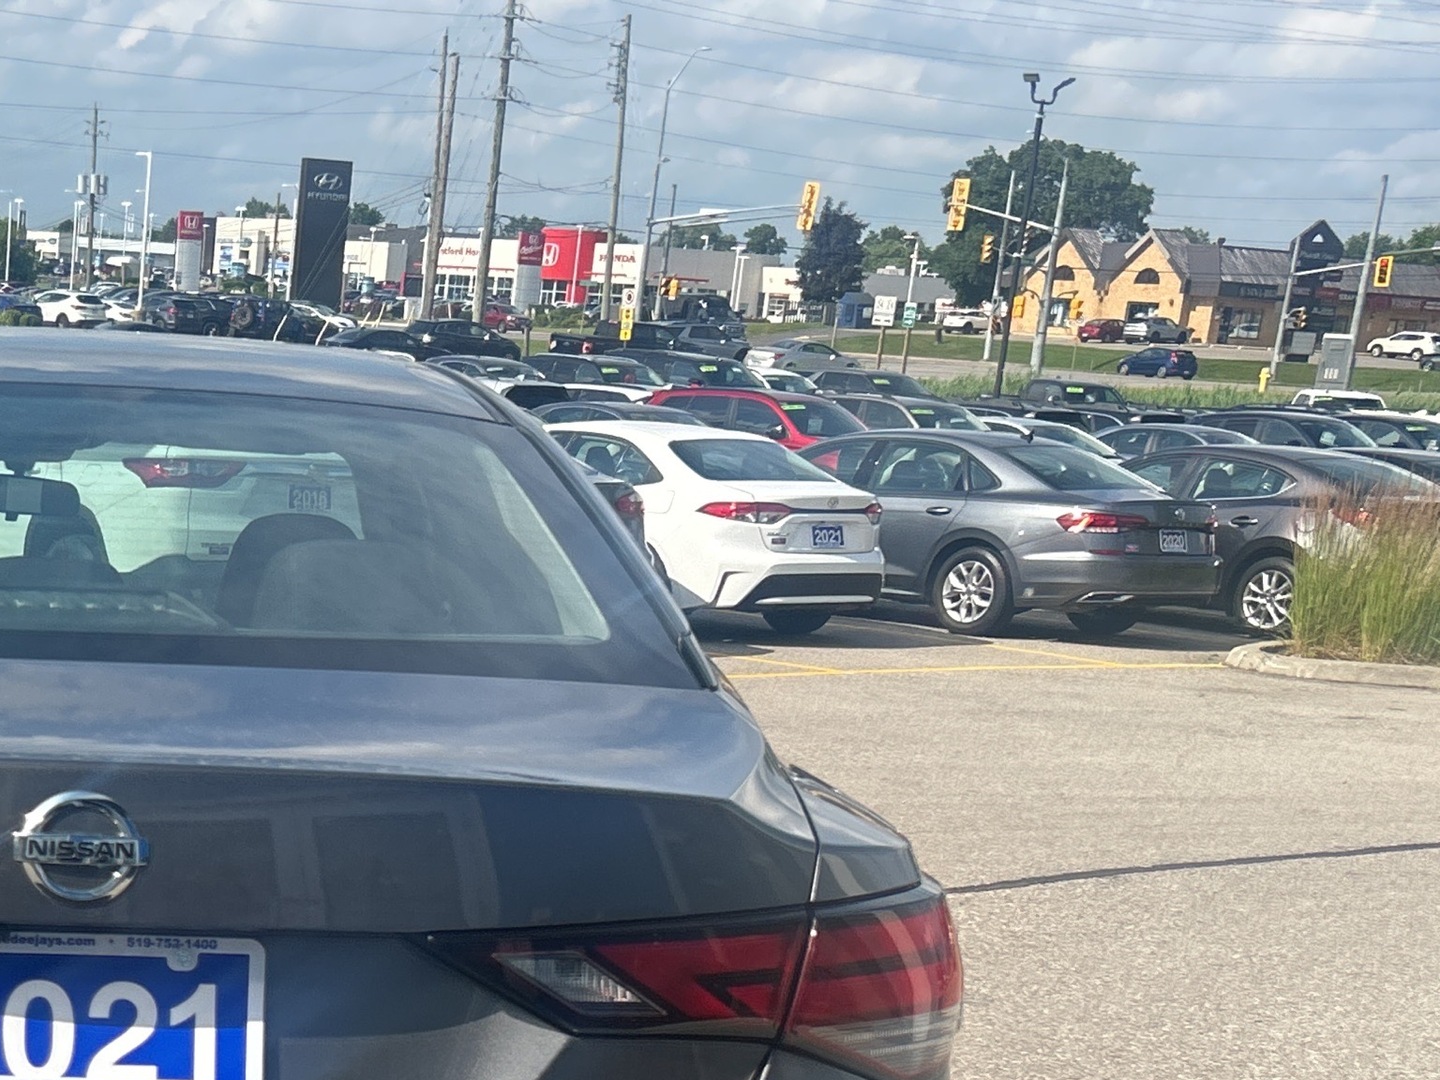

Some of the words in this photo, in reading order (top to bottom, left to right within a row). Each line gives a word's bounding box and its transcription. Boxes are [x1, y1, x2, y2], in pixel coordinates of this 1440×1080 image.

[600, 254, 636, 263] HNDA
[814, 529, 842, 543] 2021
[1162, 535, 1185, 548] 2020
[27, 839, 135, 860] NISSAN
